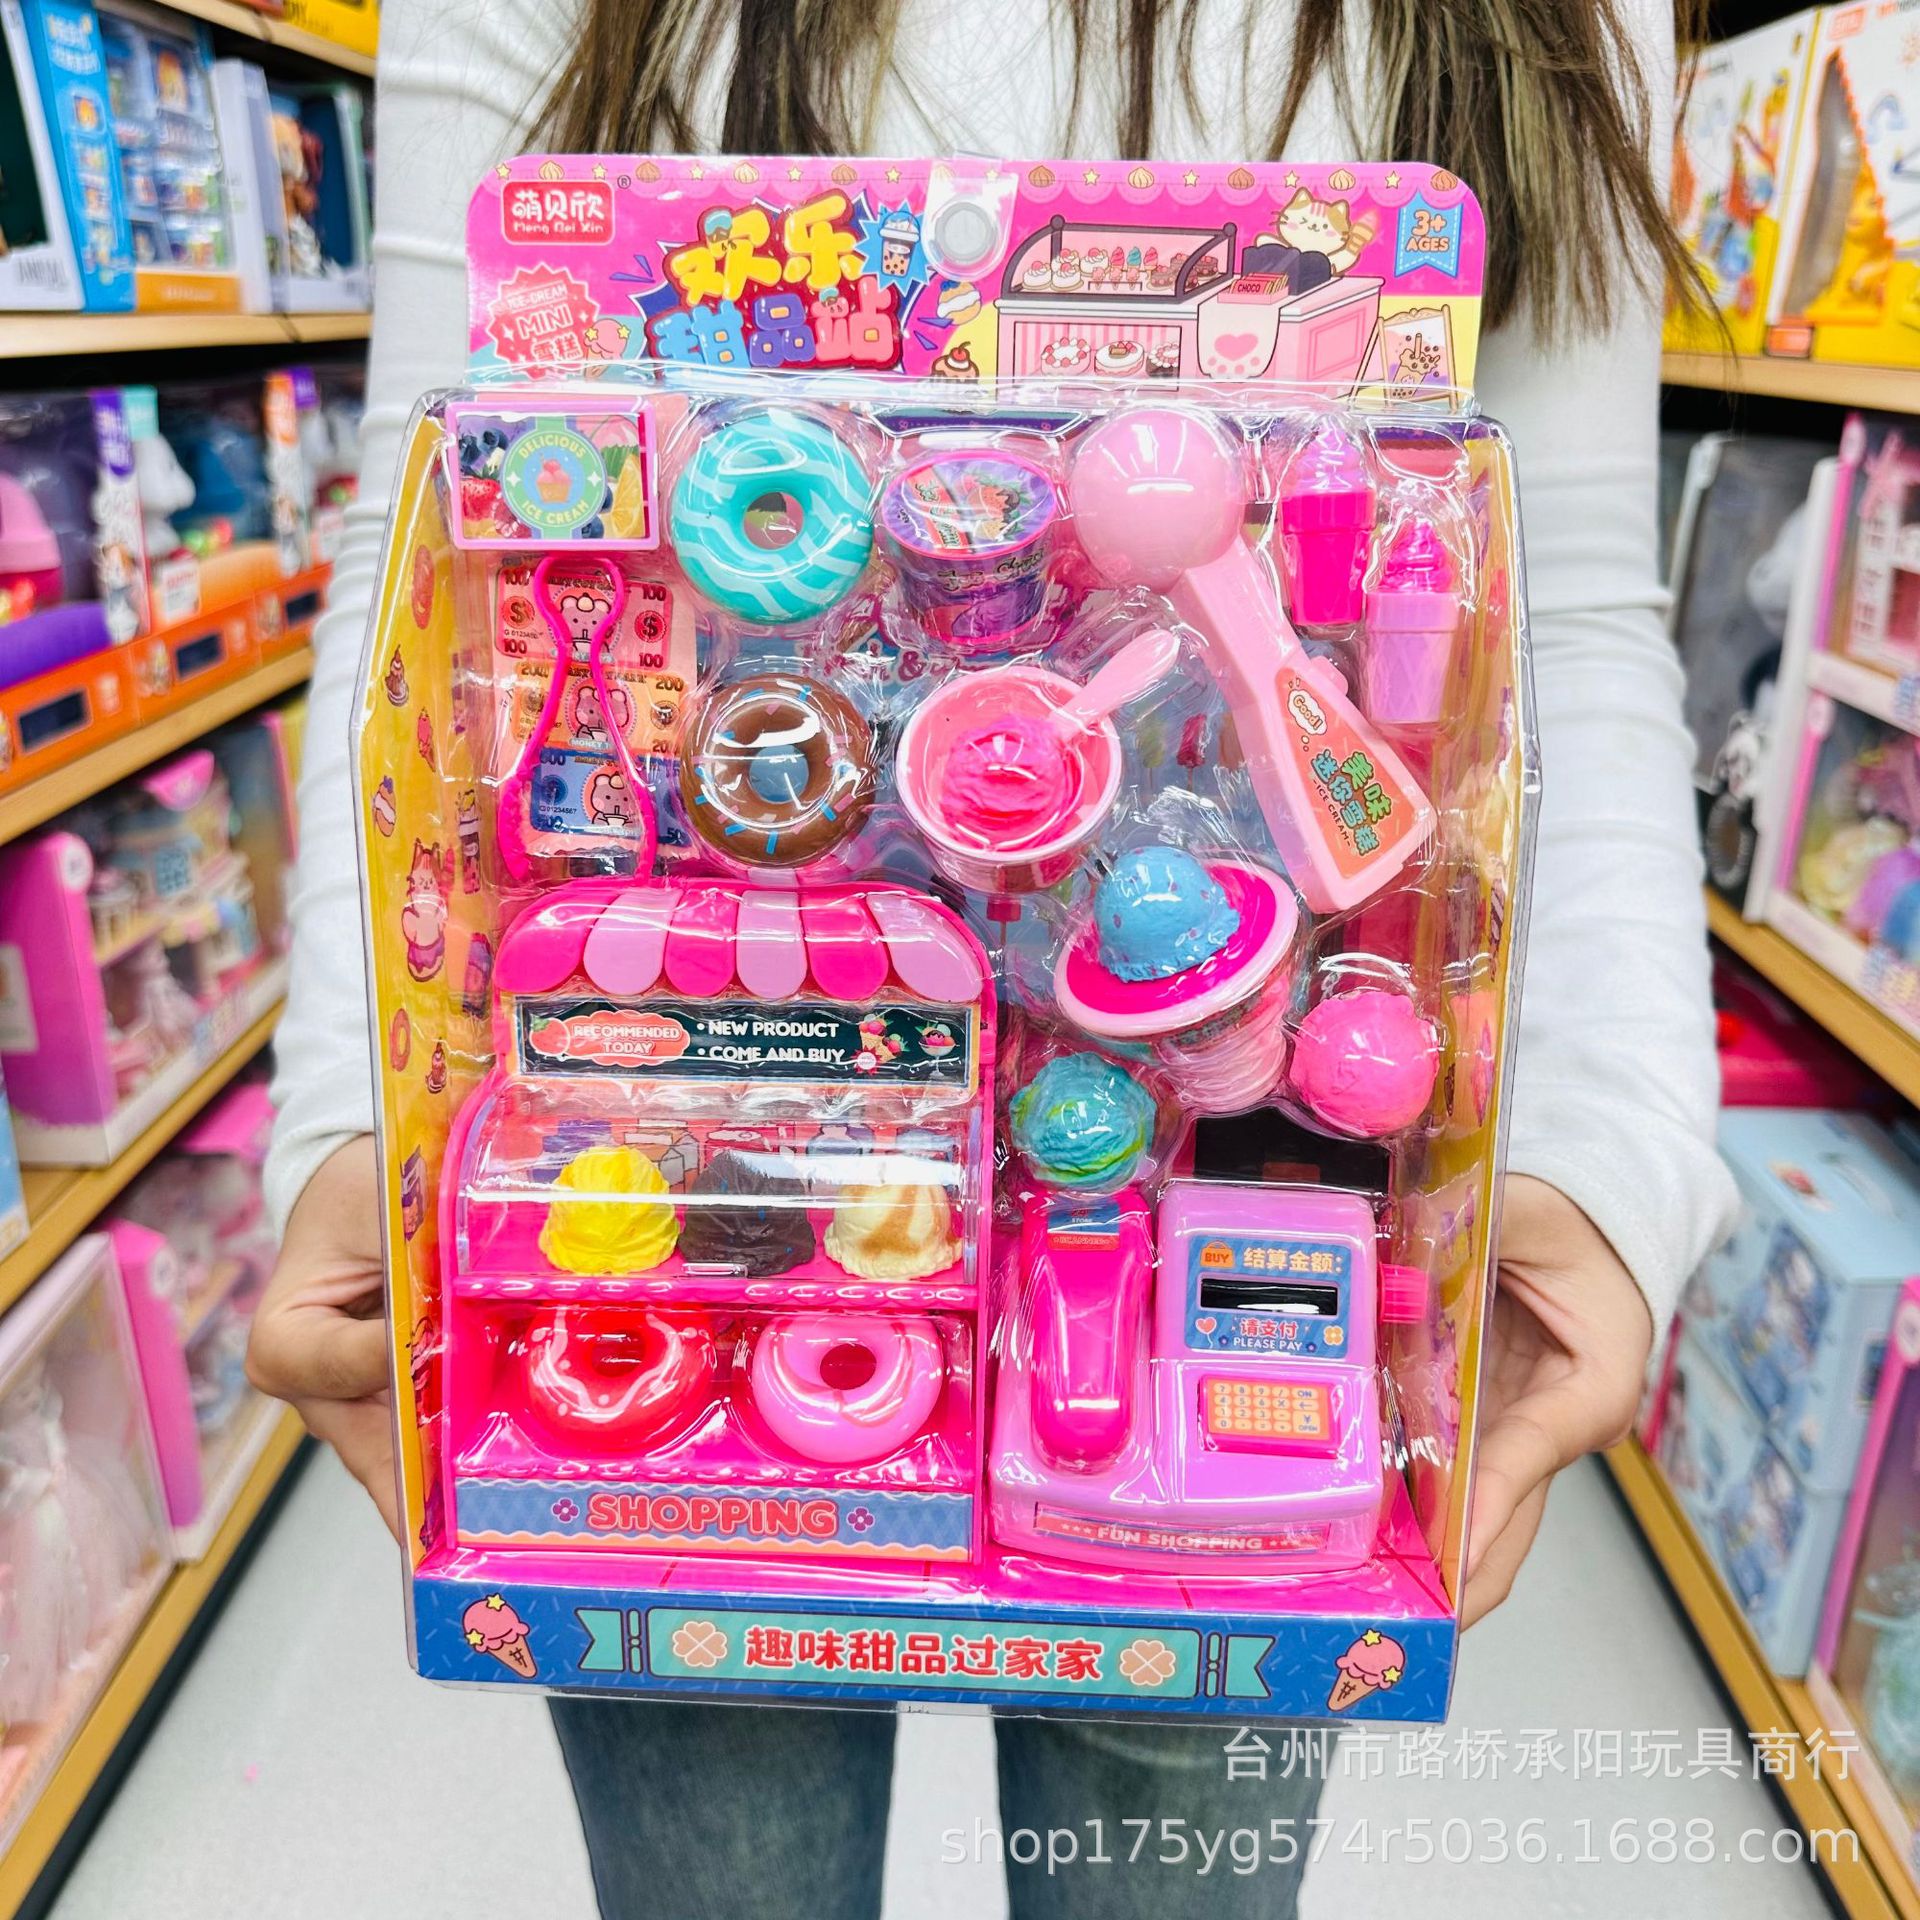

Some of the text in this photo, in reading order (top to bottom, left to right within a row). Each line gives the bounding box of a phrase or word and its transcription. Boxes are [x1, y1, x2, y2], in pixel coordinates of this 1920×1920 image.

[512, 189, 606, 223] 萌贝欣
[1413, 209, 1447, 238] 3+
[671, 195, 862, 306] 欢乐
[1405, 234, 1450, 253] AGES
[1237, 283, 1262, 294] CHOCO
[516, 303, 574, 340] MINI
[653, 278, 896, 369] 甜品站
[518, 435, 587, 459] DELICIOUS
[522, 500, 590, 525] ICE CREAM
[642, 586, 667, 602] 100
[504, 639, 527, 654] 100
[638, 653, 664, 668] 100
[656, 676, 684, 692] 200
[1292, 694, 1324, 731] Good!
[1341, 751, 1392, 823] 美味
[1311, 749, 1380, 856] 迷你雪糕
[1316, 784, 1349, 840] ICE CREAM
[573, 1024, 681, 1042] RECOMMENDED
[708, 1020, 839, 1039] NEW PRODUCT
[603, 1040, 654, 1056] TODAY
[709, 1045, 762, 1063] COME
[765, 1046, 804, 1063] AND
[807, 1047, 846, 1065] BUY
[1204, 1252, 1230, 1263] BUY
[1240, 1317, 1298, 1340] 请支付
[1233, 1337, 1303, 1351] PLEASE PAY
[588, 1493, 838, 1538] SHOPPING
[1098, 1526, 1263, 1550] FUN SHOPPING
[743, 1625, 1104, 1680] 趣味甜品过家家
